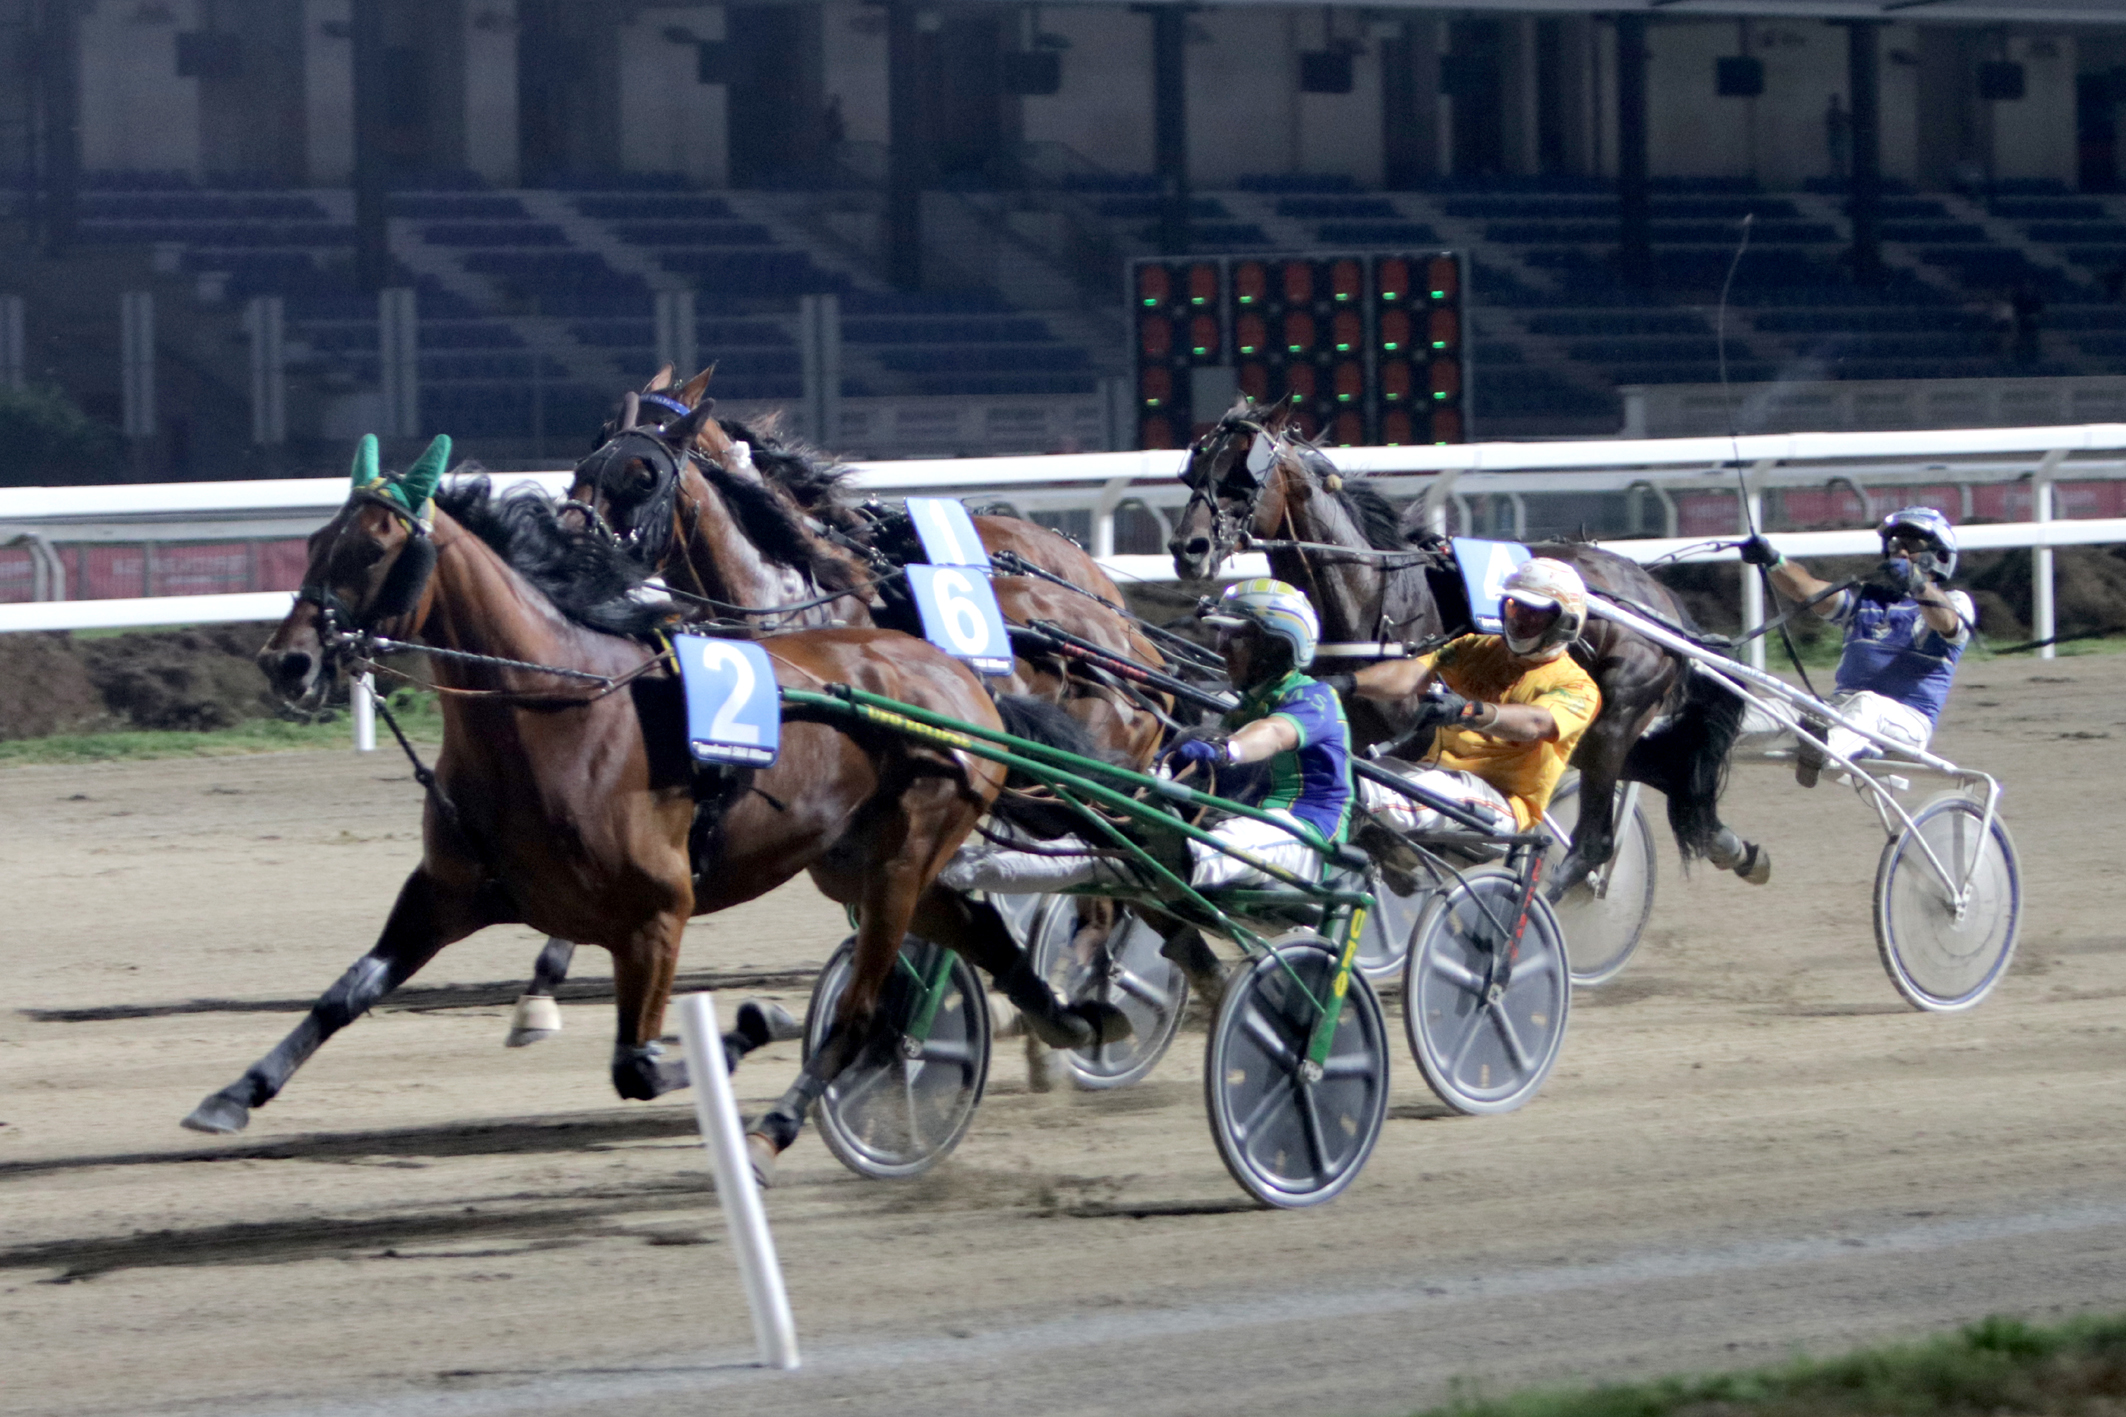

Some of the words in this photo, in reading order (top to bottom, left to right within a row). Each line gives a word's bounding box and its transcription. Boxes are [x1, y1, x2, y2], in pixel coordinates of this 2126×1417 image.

[929, 499, 966, 565] 1
[1484, 543, 1519, 600] 4
[932, 568, 989, 656] 6
[703, 641, 759, 743] 2
